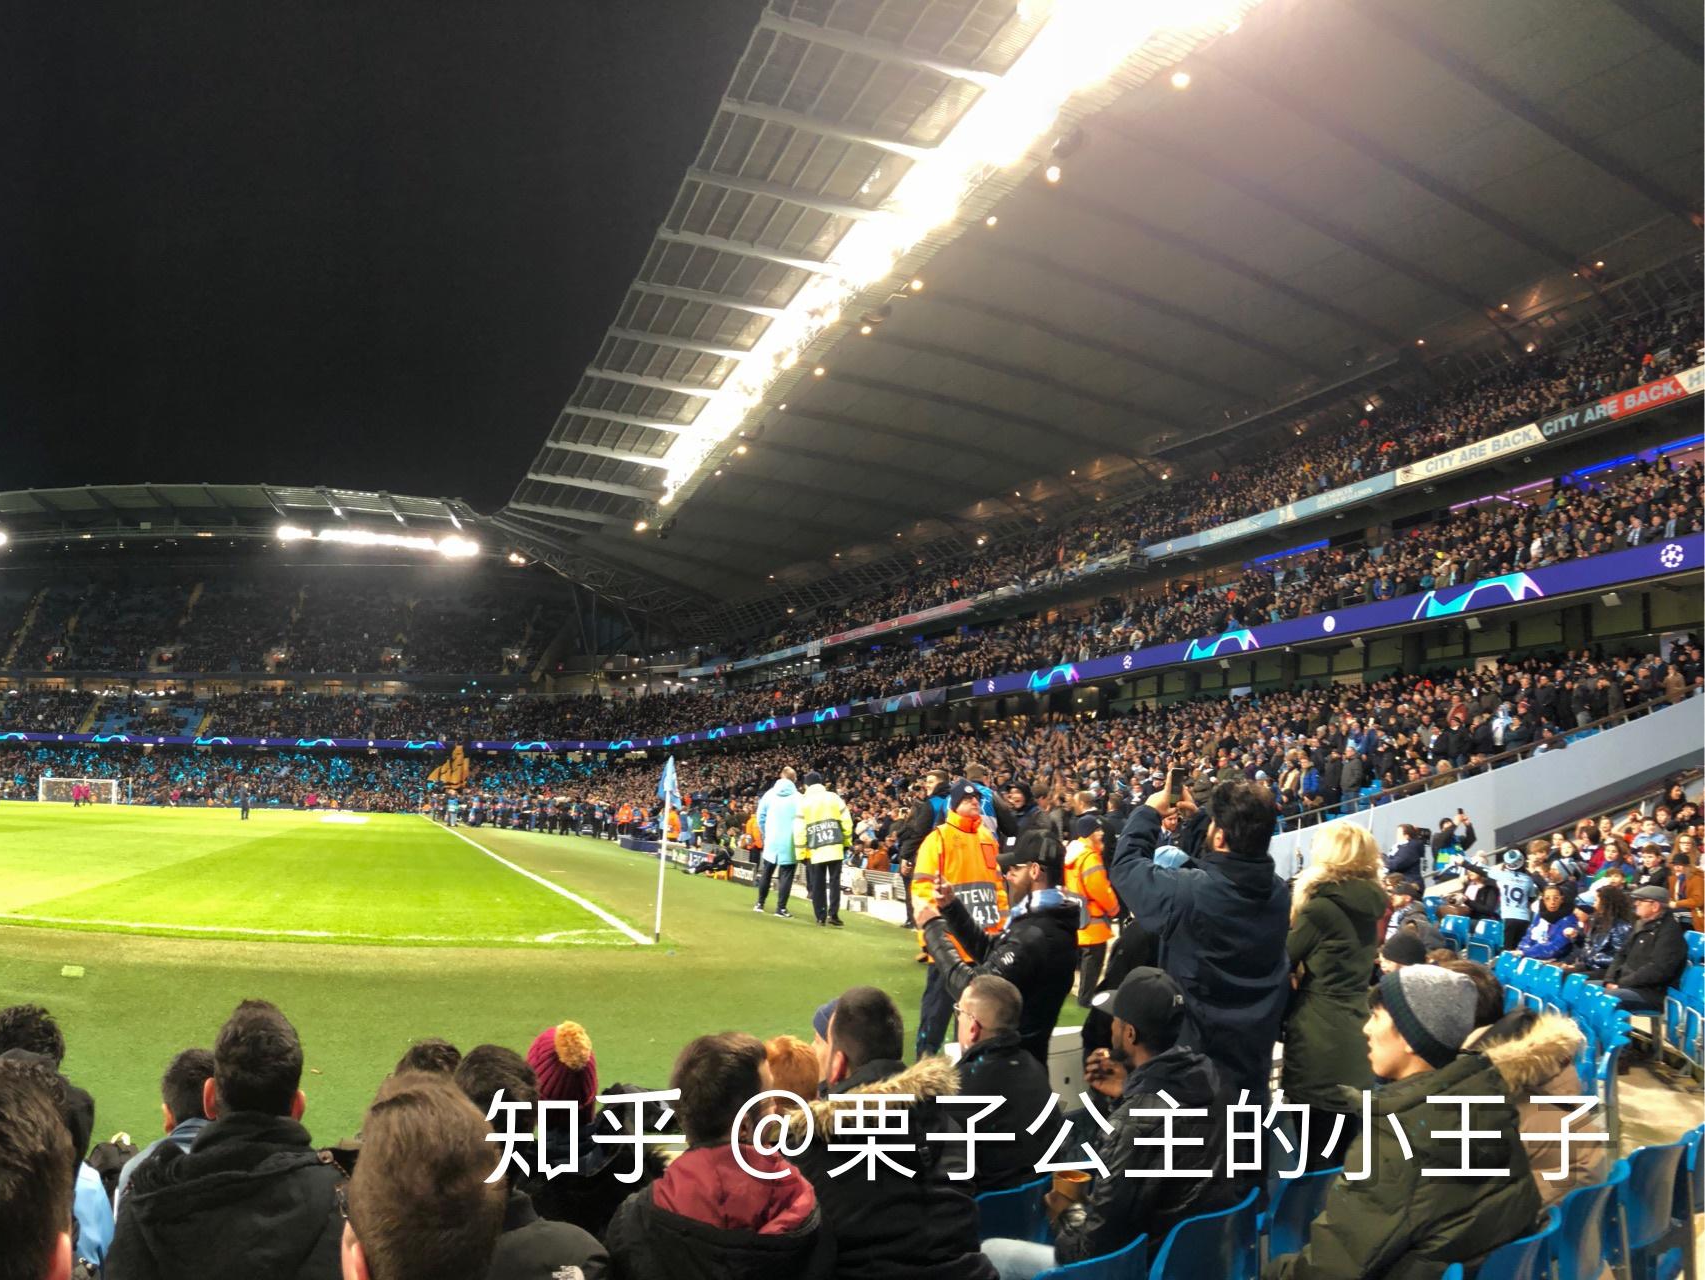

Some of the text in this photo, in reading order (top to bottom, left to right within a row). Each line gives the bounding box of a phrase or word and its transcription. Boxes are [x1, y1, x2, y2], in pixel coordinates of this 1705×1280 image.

[1542, 412, 1580, 437] CITY
[1583, 402, 1619, 425] ARE
[1424, 452, 1454, 474] CITY
[1458, 442, 1487, 467] ARE
[1502, 884, 1525, 907] 19
